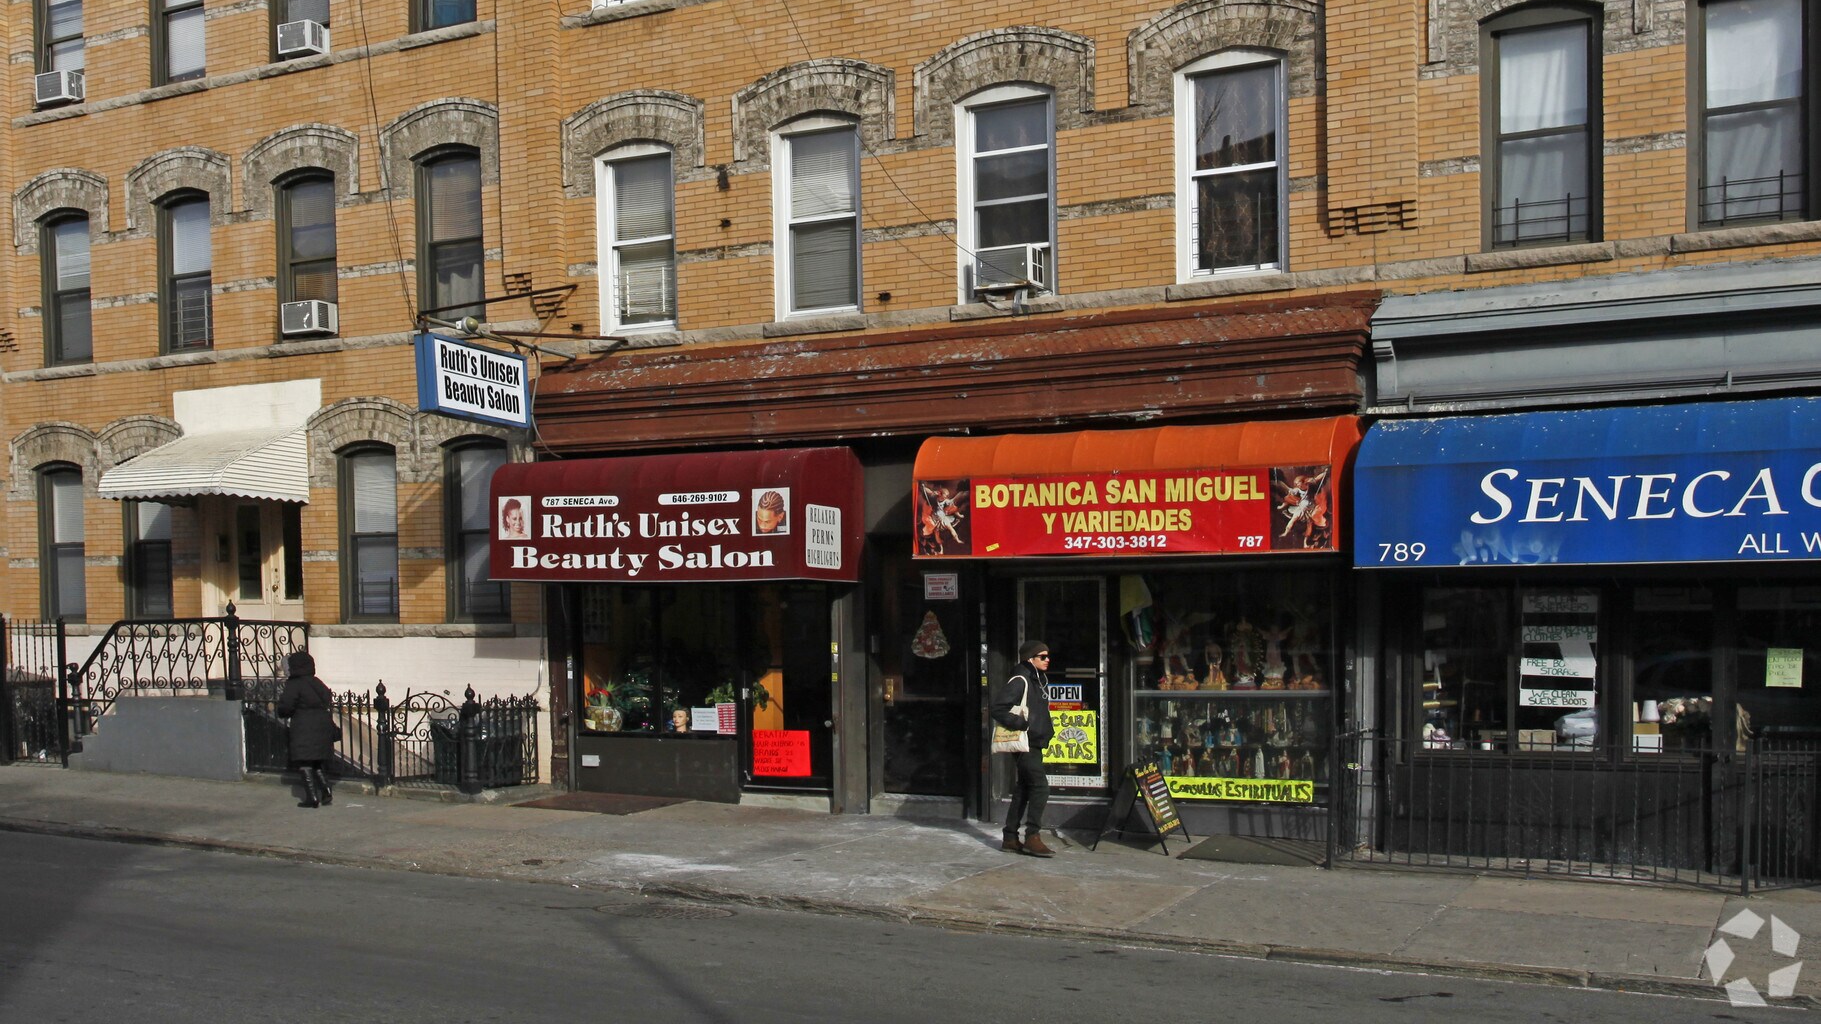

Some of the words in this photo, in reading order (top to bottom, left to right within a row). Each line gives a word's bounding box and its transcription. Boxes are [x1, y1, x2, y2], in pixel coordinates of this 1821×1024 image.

[440, 344, 478, 376] Ruth's
[480, 354, 520, 386] Unisex
[444, 375, 485, 409] Beauty
[487, 385, 520, 414] Salon
[672, 493, 728, 503] 646-269-9102
[975, 481, 1098, 508] BOTANICA
[1105, 479, 1156, 504] SAN
[1165, 475, 1265, 502] MIGUEL
[1470, 467, 1789, 525] SENECA
[545, 498, 560, 506] 787
[563, 498, 595, 506] SENECA
[540, 513, 631, 538] Ruth's
[637, 511, 741, 538] Unisex
[809, 507, 836, 525] RELAXER
[1042, 513, 1057, 534] Y
[1062, 508, 1192, 534] VARIEDADES
[812, 528, 834, 546] PERMS
[1064, 535, 1167, 549] 347-303-3812
[1237, 535, 1264, 548] 787
[1737, 533, 1789, 554] ALL
[510, 546, 650, 576] Beauty
[658, 544, 775, 571] Salon
[807, 548, 839, 567] HIGHLIGHTS
[1378, 542, 1427, 562] 789
[1526, 658, 1548, 667] FREE
[1050, 686, 1080, 700] OPEN
[1528, 697, 1559, 706] SUEDE
[1562, 698, 1588, 706] BOOTS
[1531, 689, 1549, 698] WE
[1551, 690, 1578, 699] CLEAN
